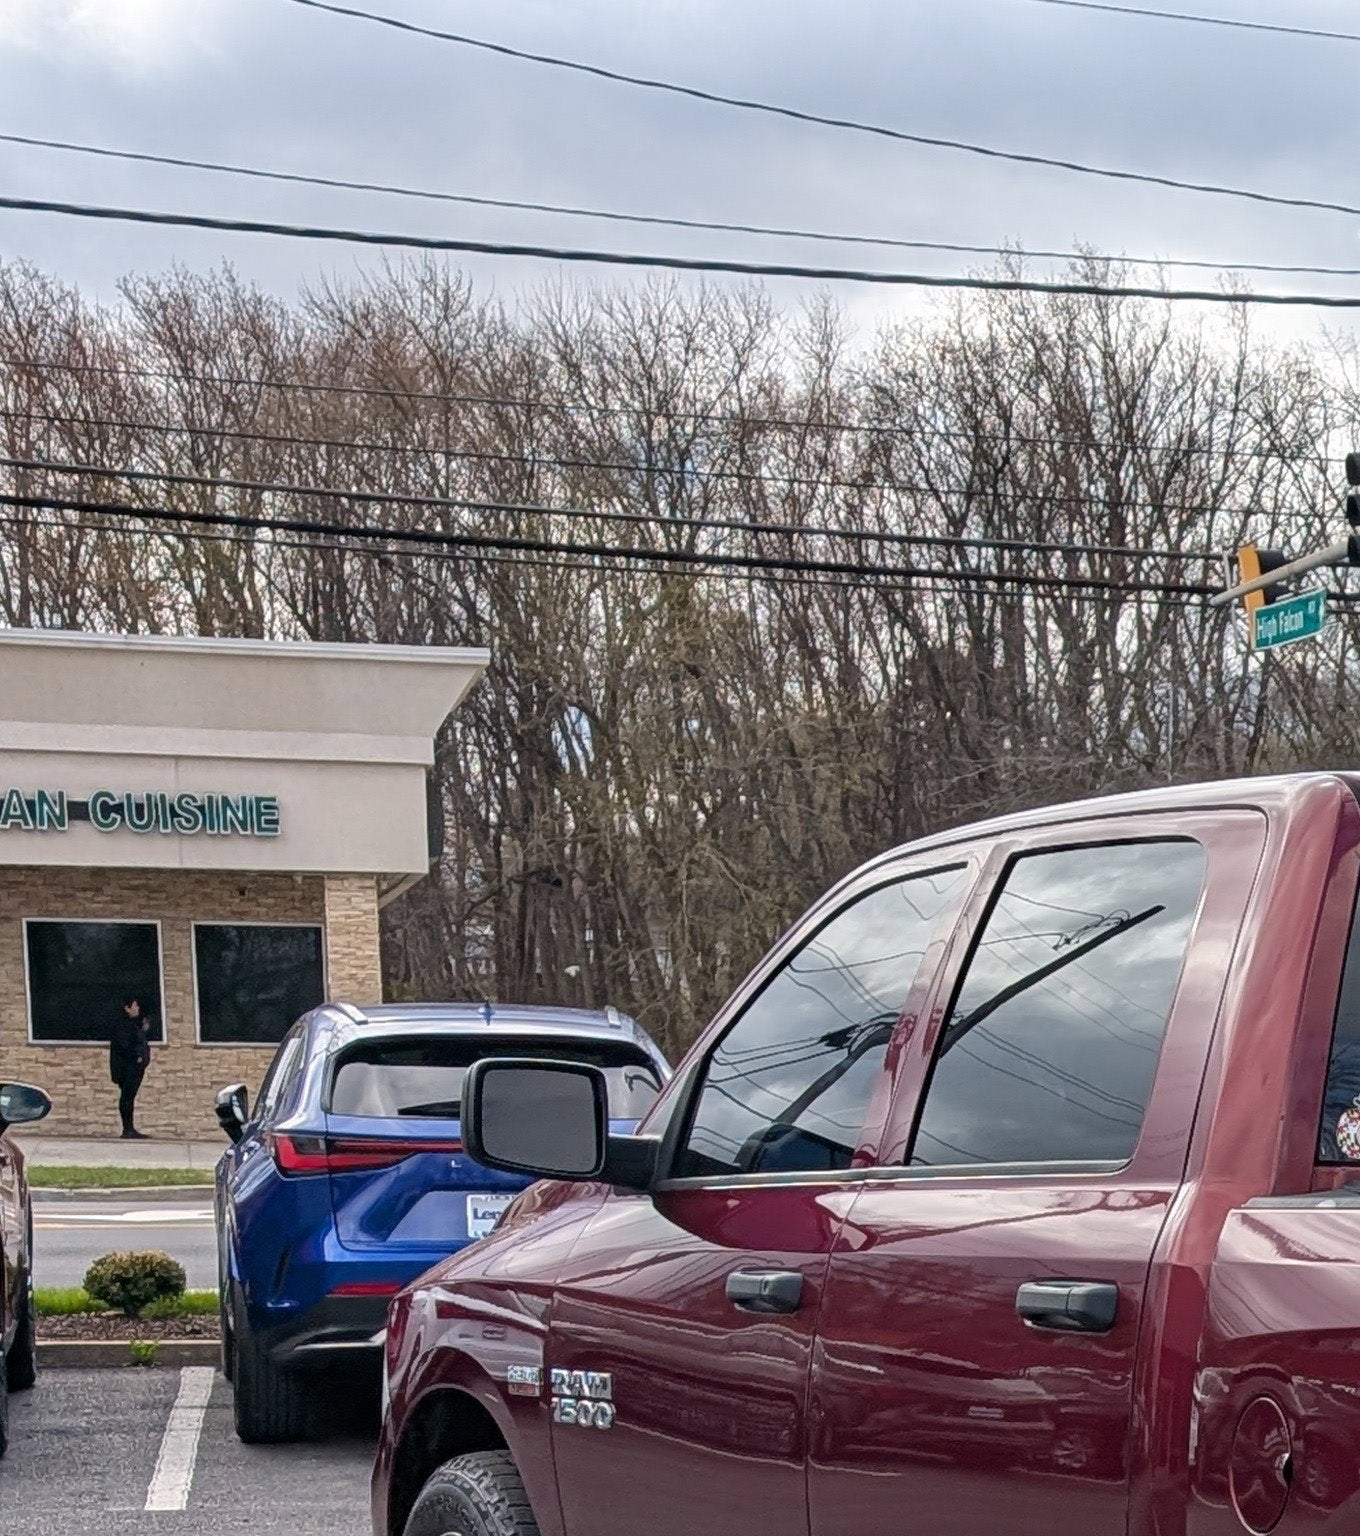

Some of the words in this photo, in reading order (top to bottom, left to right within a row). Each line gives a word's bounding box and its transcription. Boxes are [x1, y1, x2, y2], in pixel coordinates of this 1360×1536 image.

[1256, 614, 1278, 645] High
[1279, 609, 1304, 635] Falcon
[0, 787, 69, 831] AN
[88, 788, 281, 837] CUISINE
[550, 1368, 613, 1400] RAM
[550, 1397, 617, 1430] 1500
